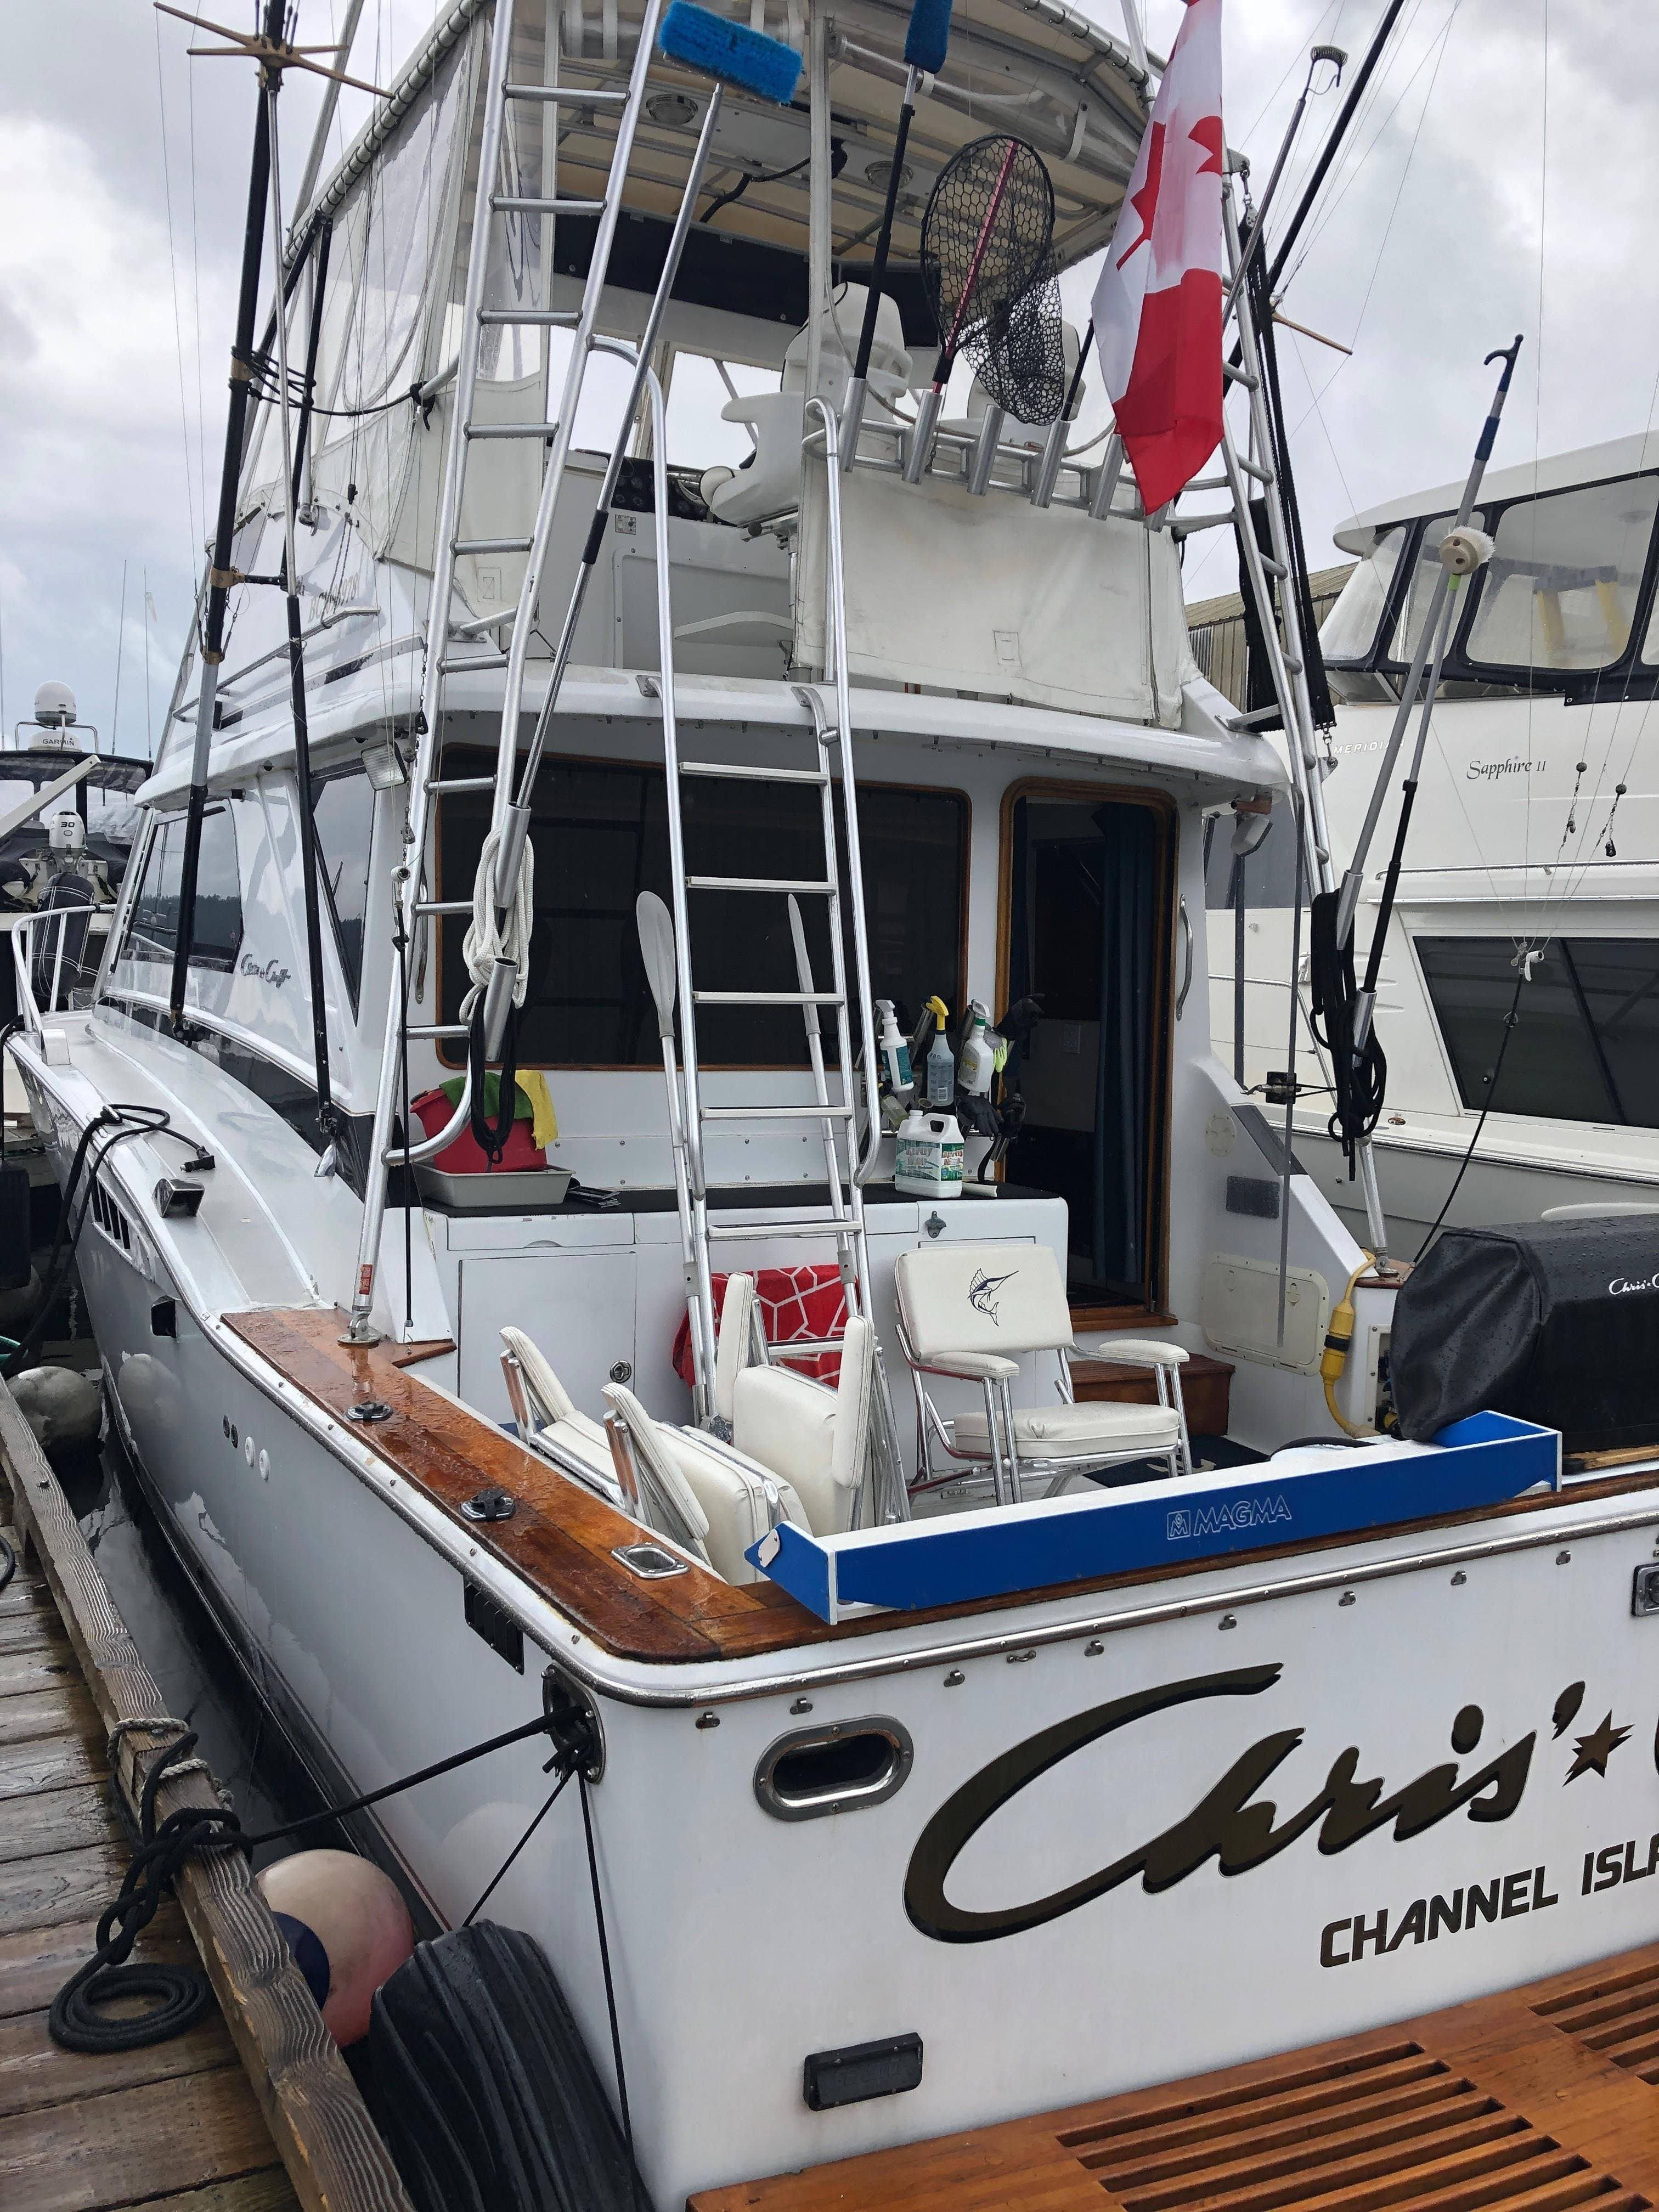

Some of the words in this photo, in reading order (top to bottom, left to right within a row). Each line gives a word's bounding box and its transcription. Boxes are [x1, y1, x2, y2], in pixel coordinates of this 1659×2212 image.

[1466, 756, 1532, 780] Sapphire
[1193, 1494, 1292, 1536] MAGMA
[1320, 1865, 1559, 1968] CHANNEL
